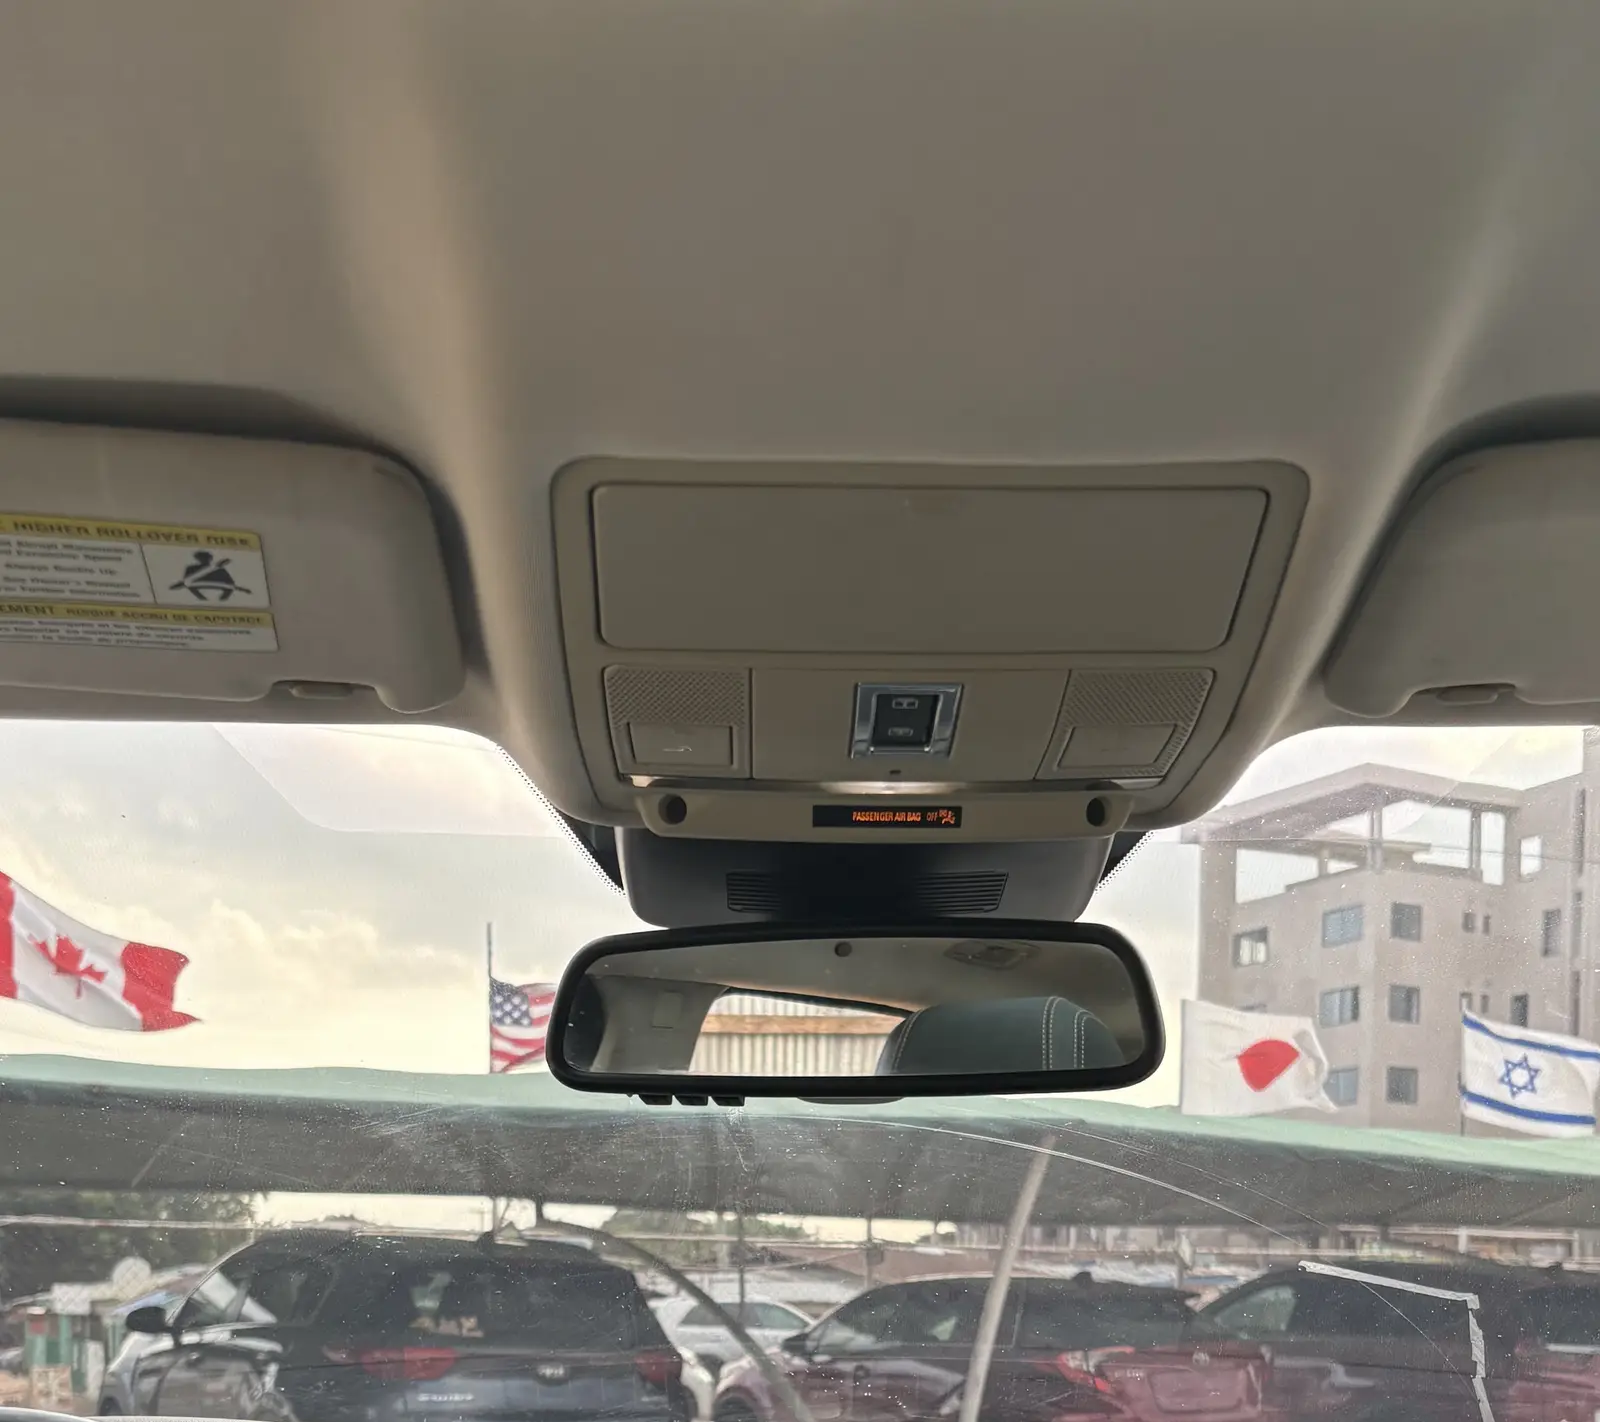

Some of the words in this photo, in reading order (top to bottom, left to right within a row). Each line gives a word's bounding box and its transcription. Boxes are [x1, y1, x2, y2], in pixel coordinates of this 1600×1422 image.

[852, 811, 893, 822] PASSENGER
[894, 811, 906, 822] AIR
[907, 811, 921, 822] BAG
[926, 812, 938, 822] OFF
